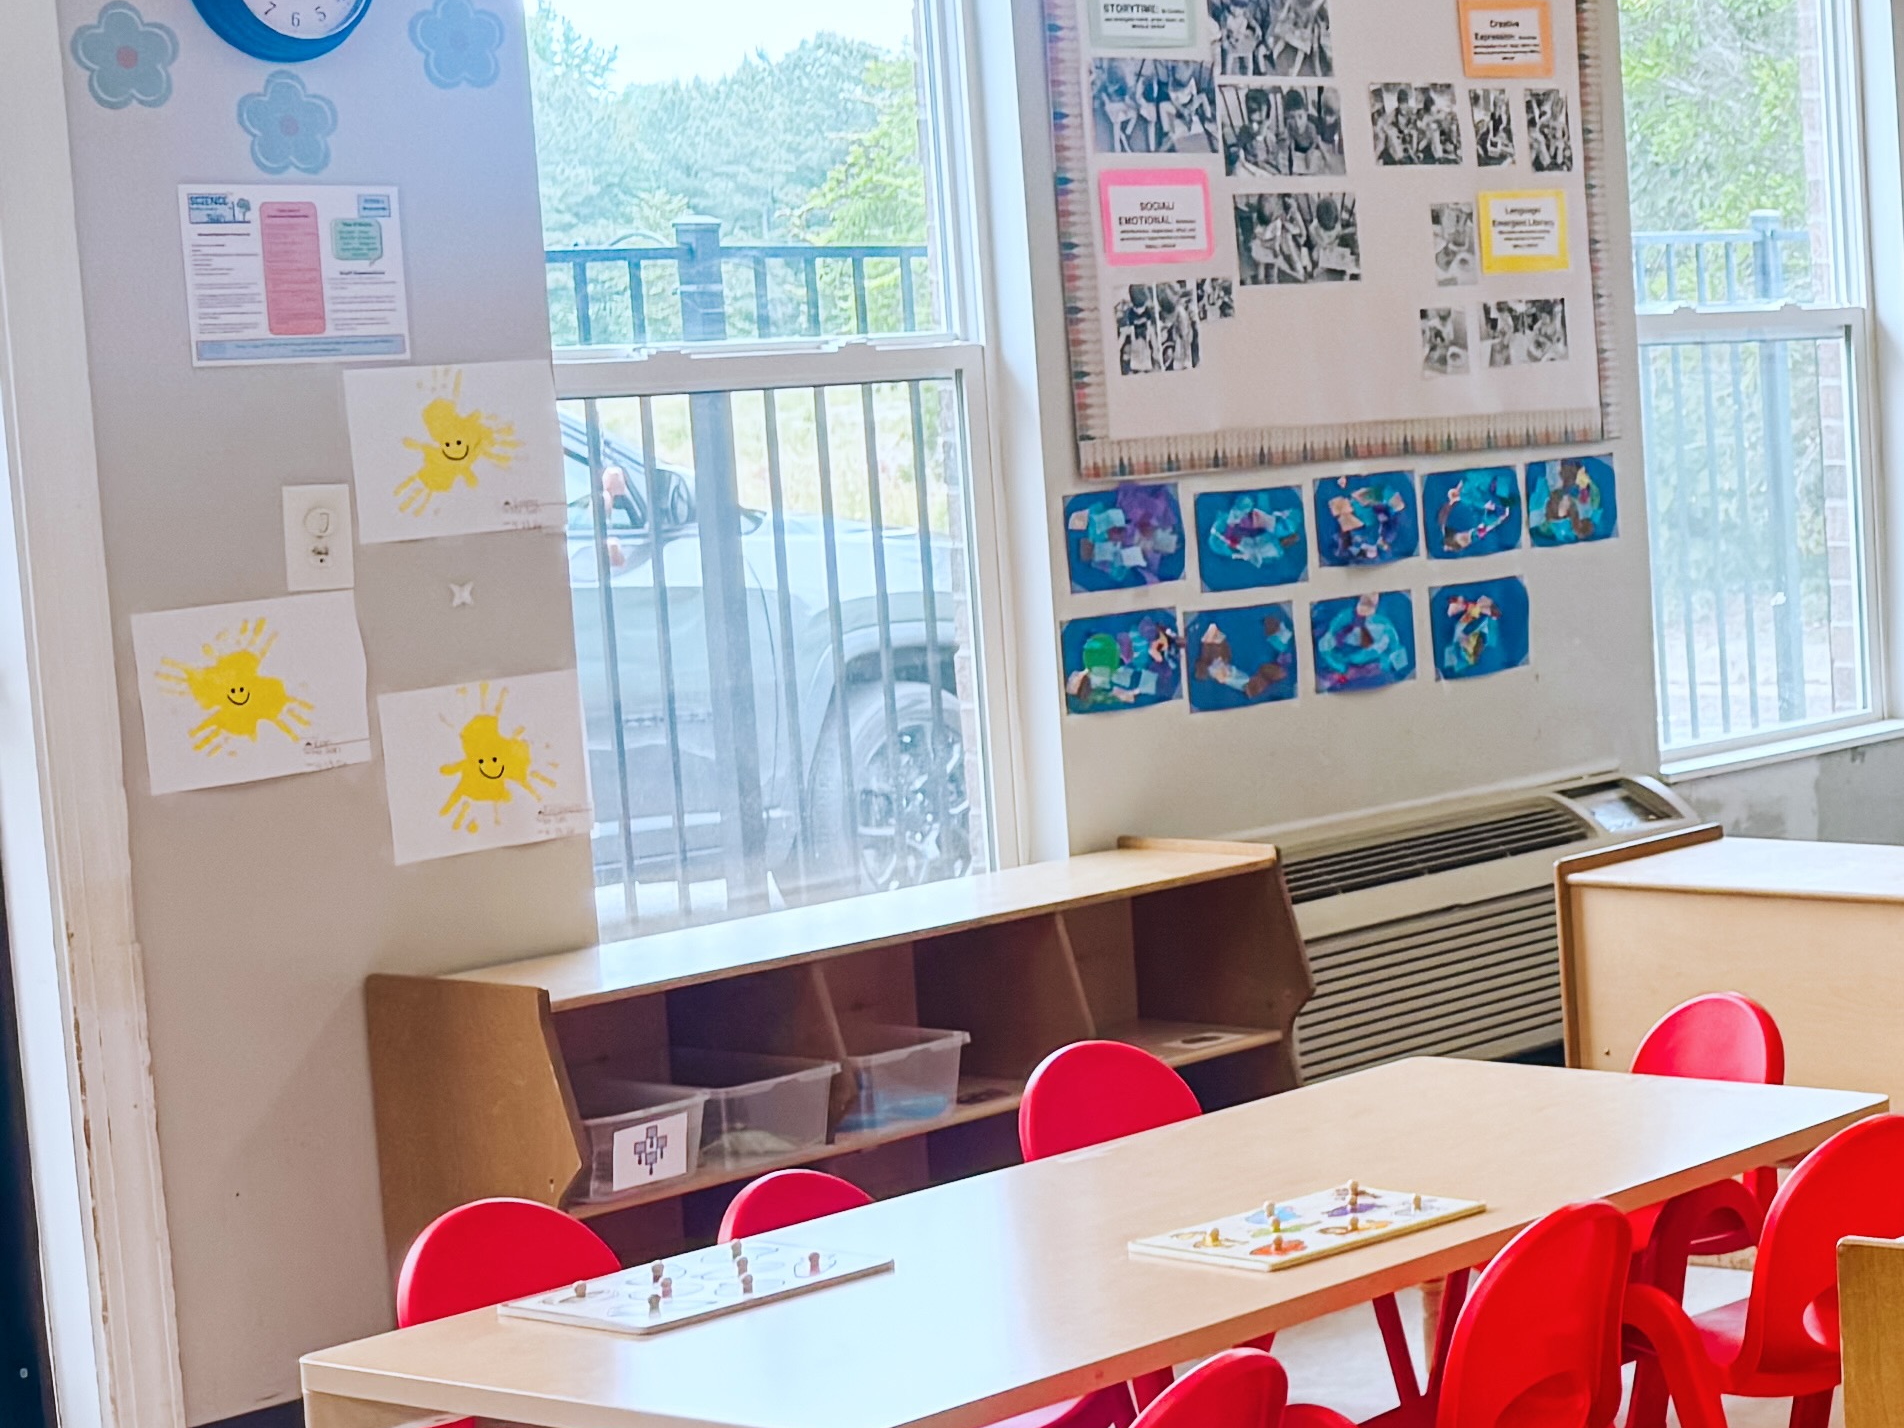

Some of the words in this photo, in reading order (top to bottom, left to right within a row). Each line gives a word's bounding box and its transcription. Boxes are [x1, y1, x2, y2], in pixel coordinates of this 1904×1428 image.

[264, 1, 277, 16] 7
[314, 6, 327, 22] 5
[291, 12, 301, 28] 6
